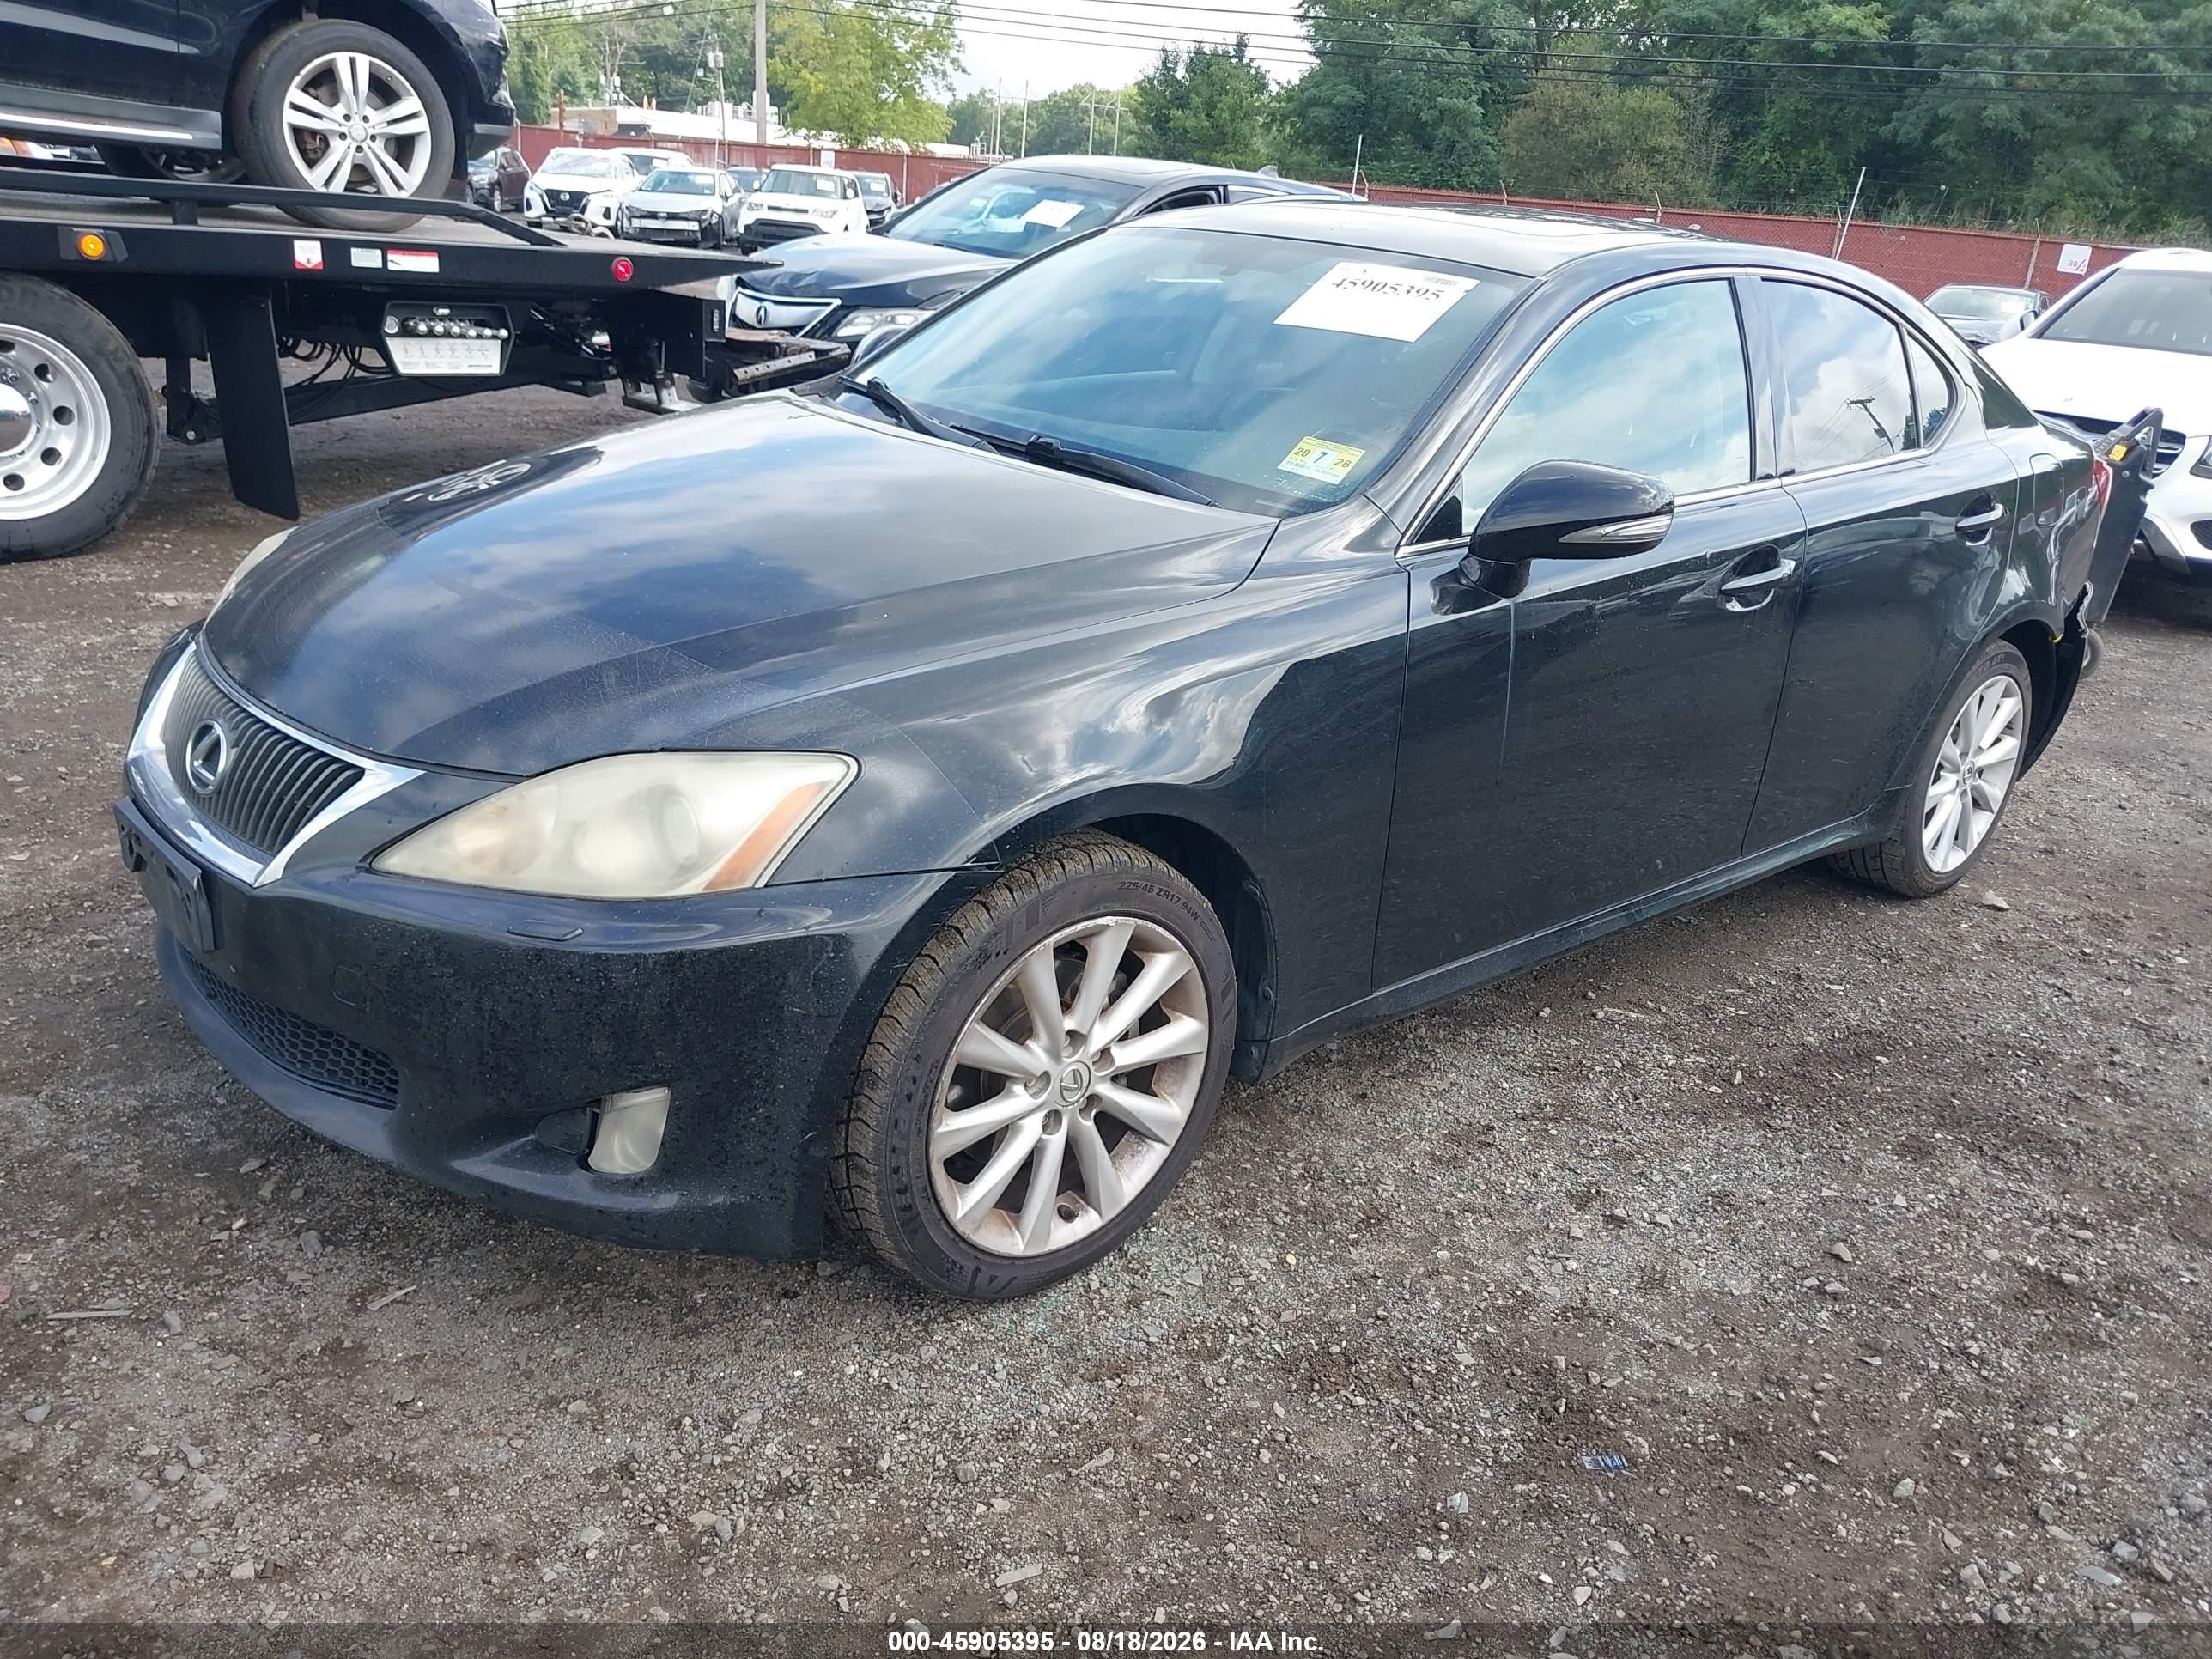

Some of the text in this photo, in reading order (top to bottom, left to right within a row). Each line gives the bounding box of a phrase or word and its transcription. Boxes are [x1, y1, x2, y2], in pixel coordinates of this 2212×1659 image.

[1332, 278, 1444, 301] 45905395
[1293, 447, 1310, 458] 20
[1313, 452, 1328, 464] 7
[1334, 458, 1352, 468] 28
[1118, 881, 1200, 921] 225/45 ZR17 94W
